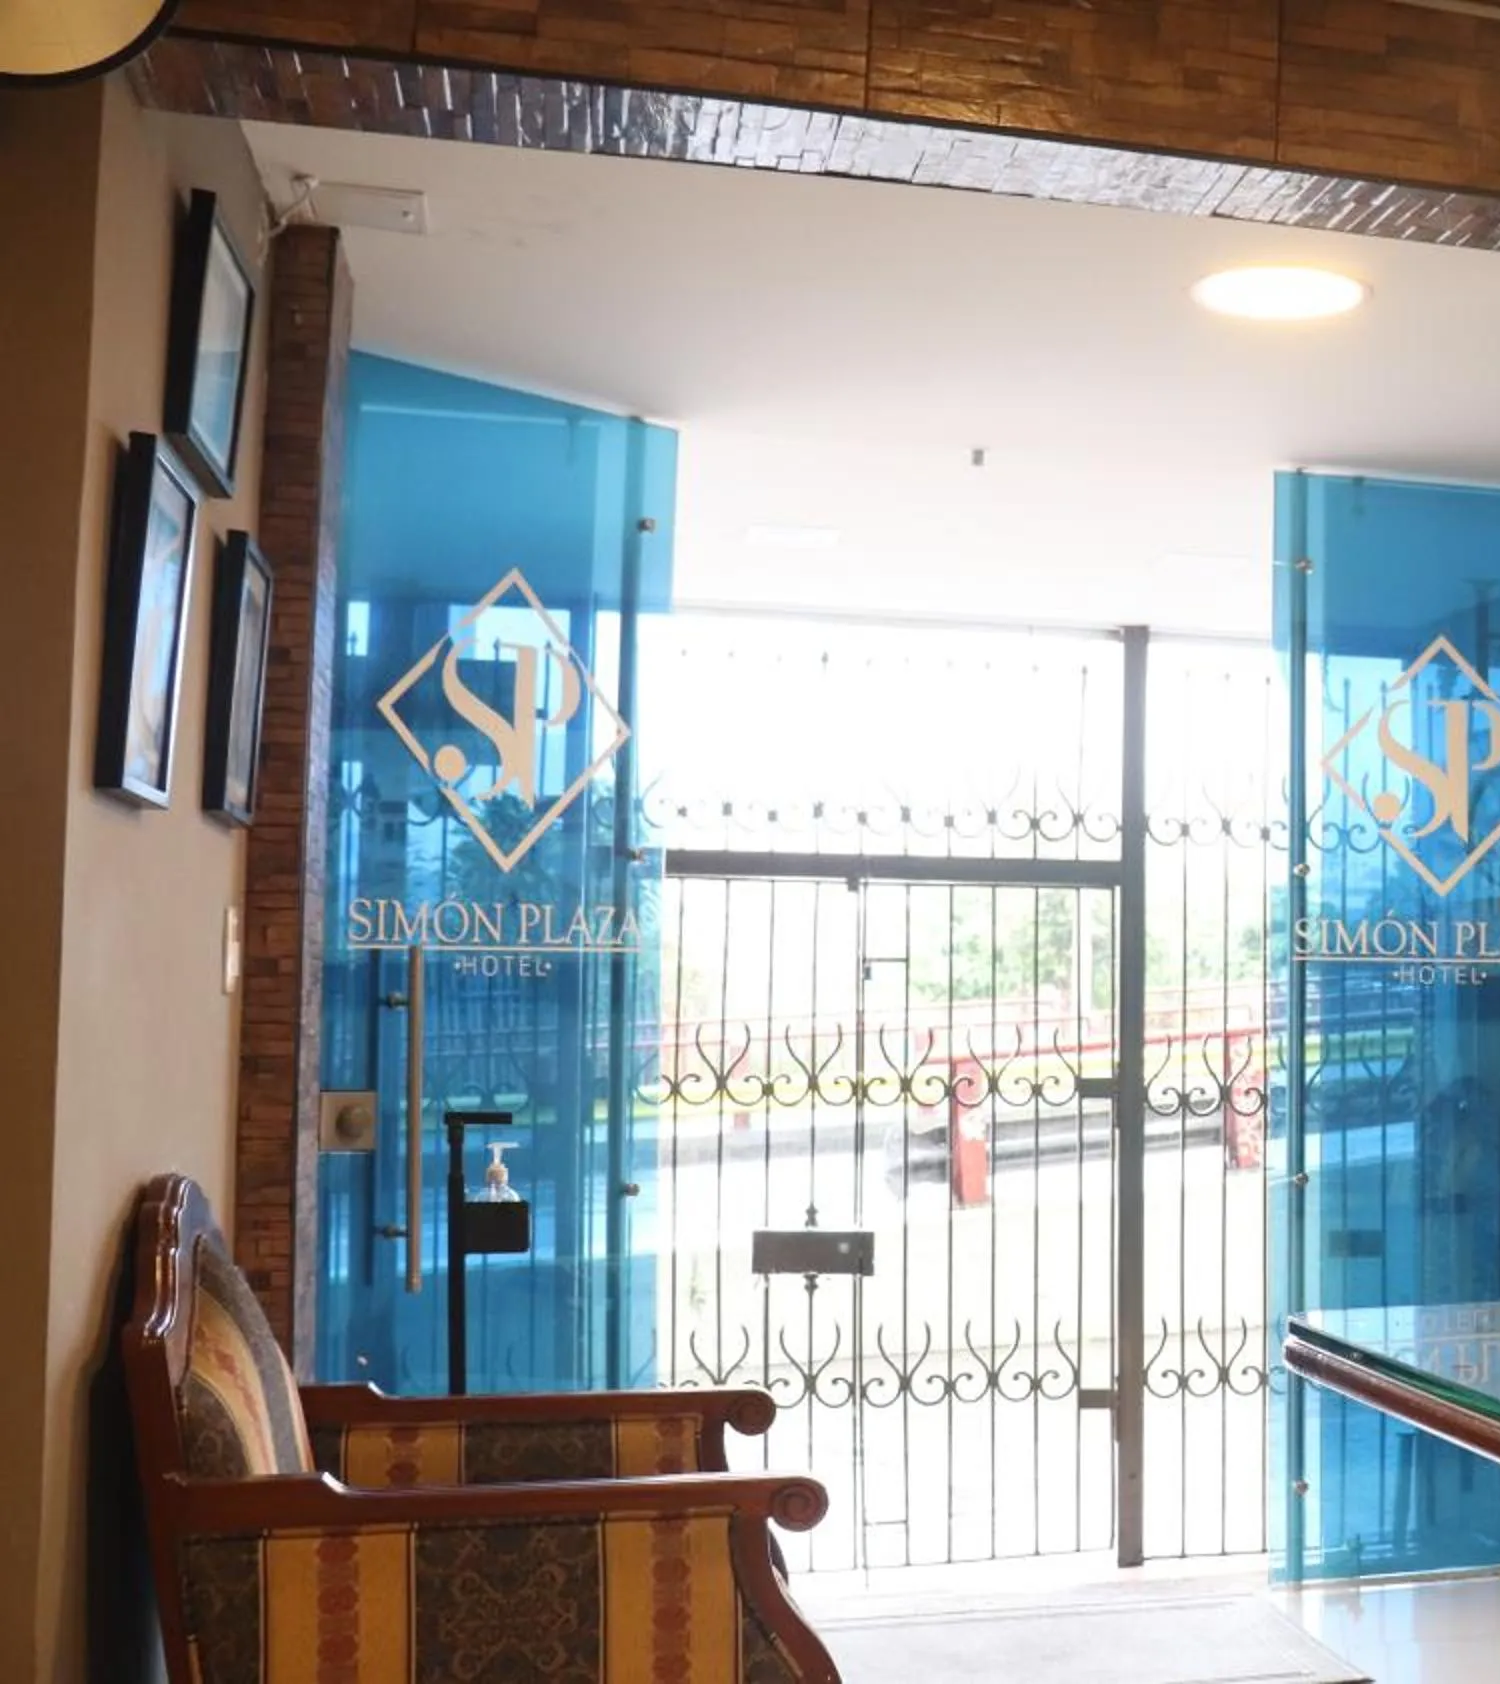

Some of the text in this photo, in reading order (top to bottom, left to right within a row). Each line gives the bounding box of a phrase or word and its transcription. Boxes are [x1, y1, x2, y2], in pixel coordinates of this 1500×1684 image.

[347, 892, 641, 946] SIMÓN PLAZA
[1294, 909, 1440, 957] SIMÓN
[460, 955, 547, 979] HOTEL
[1401, 966, 1484, 985] HOTEL
